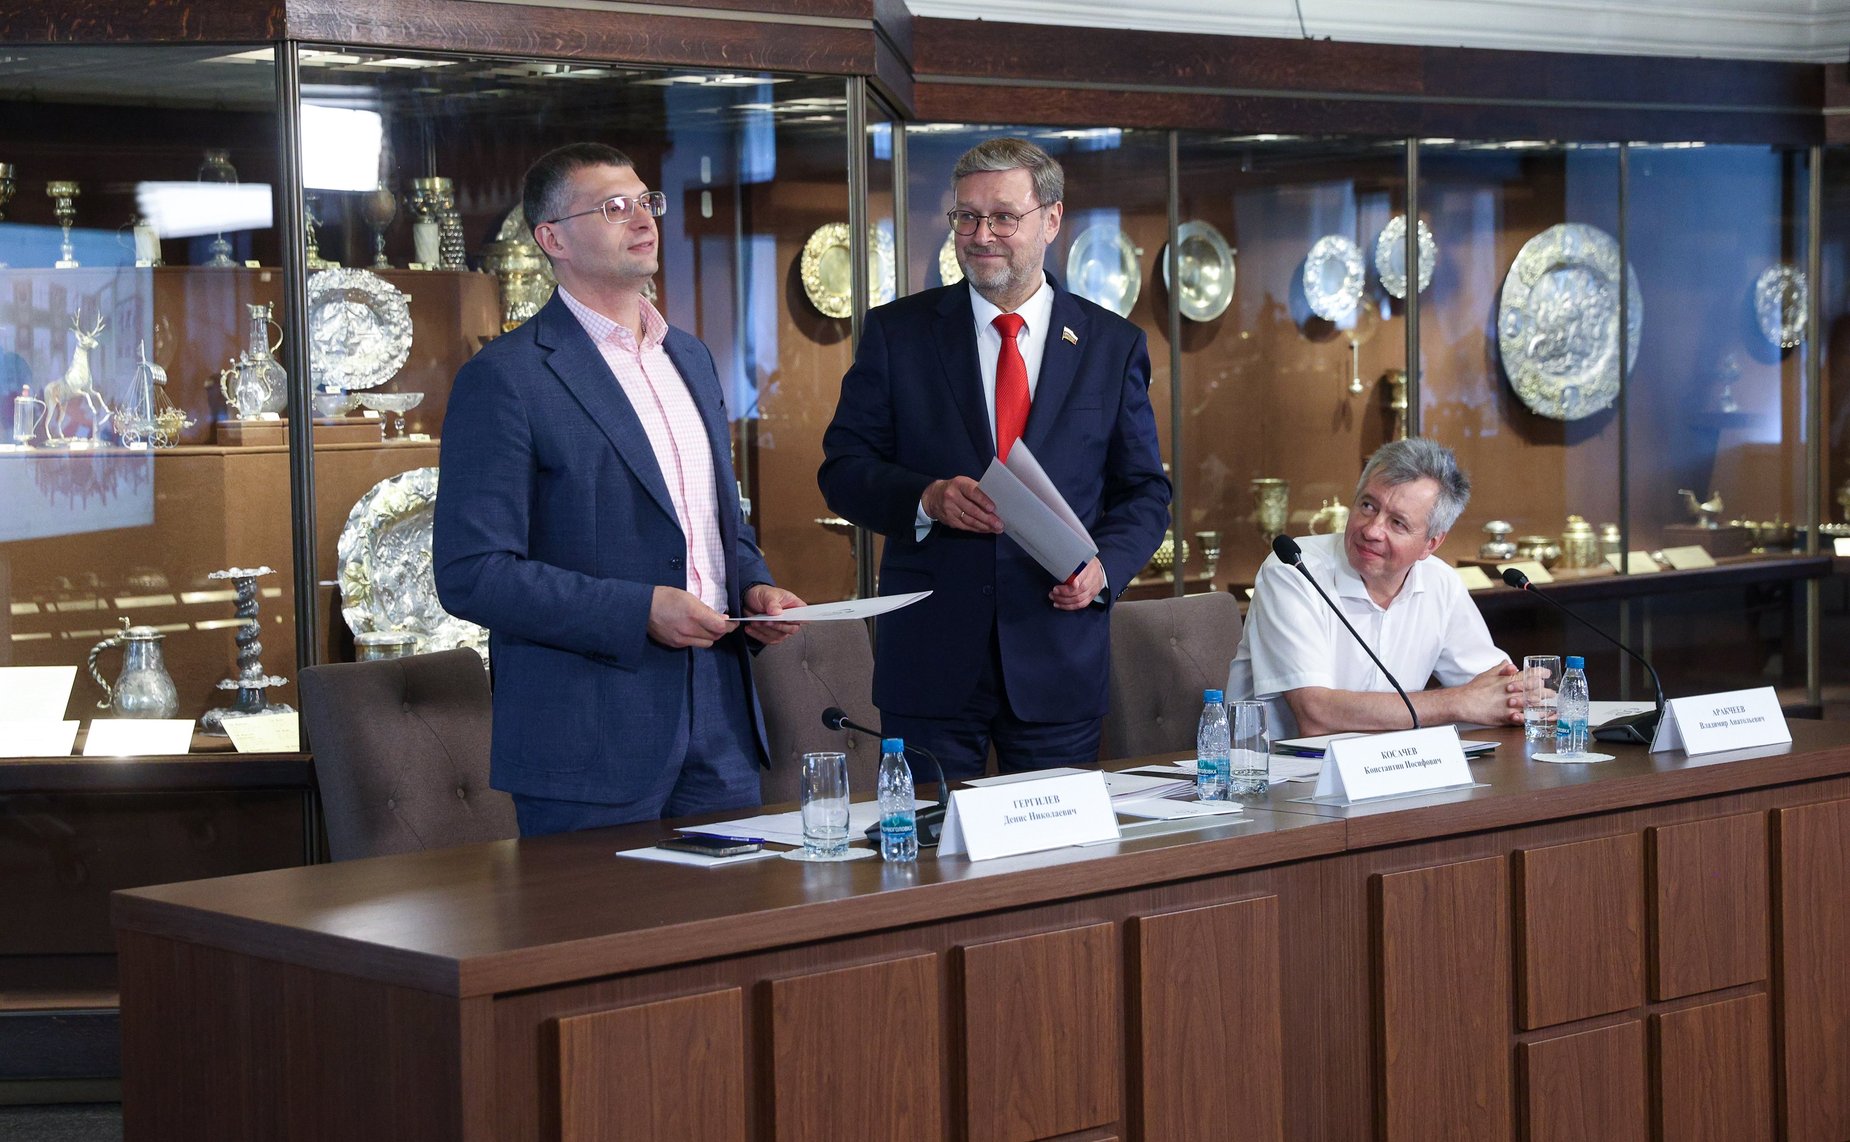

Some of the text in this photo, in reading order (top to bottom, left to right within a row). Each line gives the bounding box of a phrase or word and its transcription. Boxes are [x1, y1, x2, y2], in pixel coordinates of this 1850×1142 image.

[1712, 705, 1746, 717] АРАКЧЕЕВ
[1699, 716, 1766, 730] Владимир Анатольевич
[1380, 747, 1418, 760] КОСАЧЕВ
[1363, 758, 1442, 775] Константин Иосифович
[1013, 794, 1060, 809] ГЕРГИЛЕВ
[1003, 808, 1077, 826] Денис Николаевич
